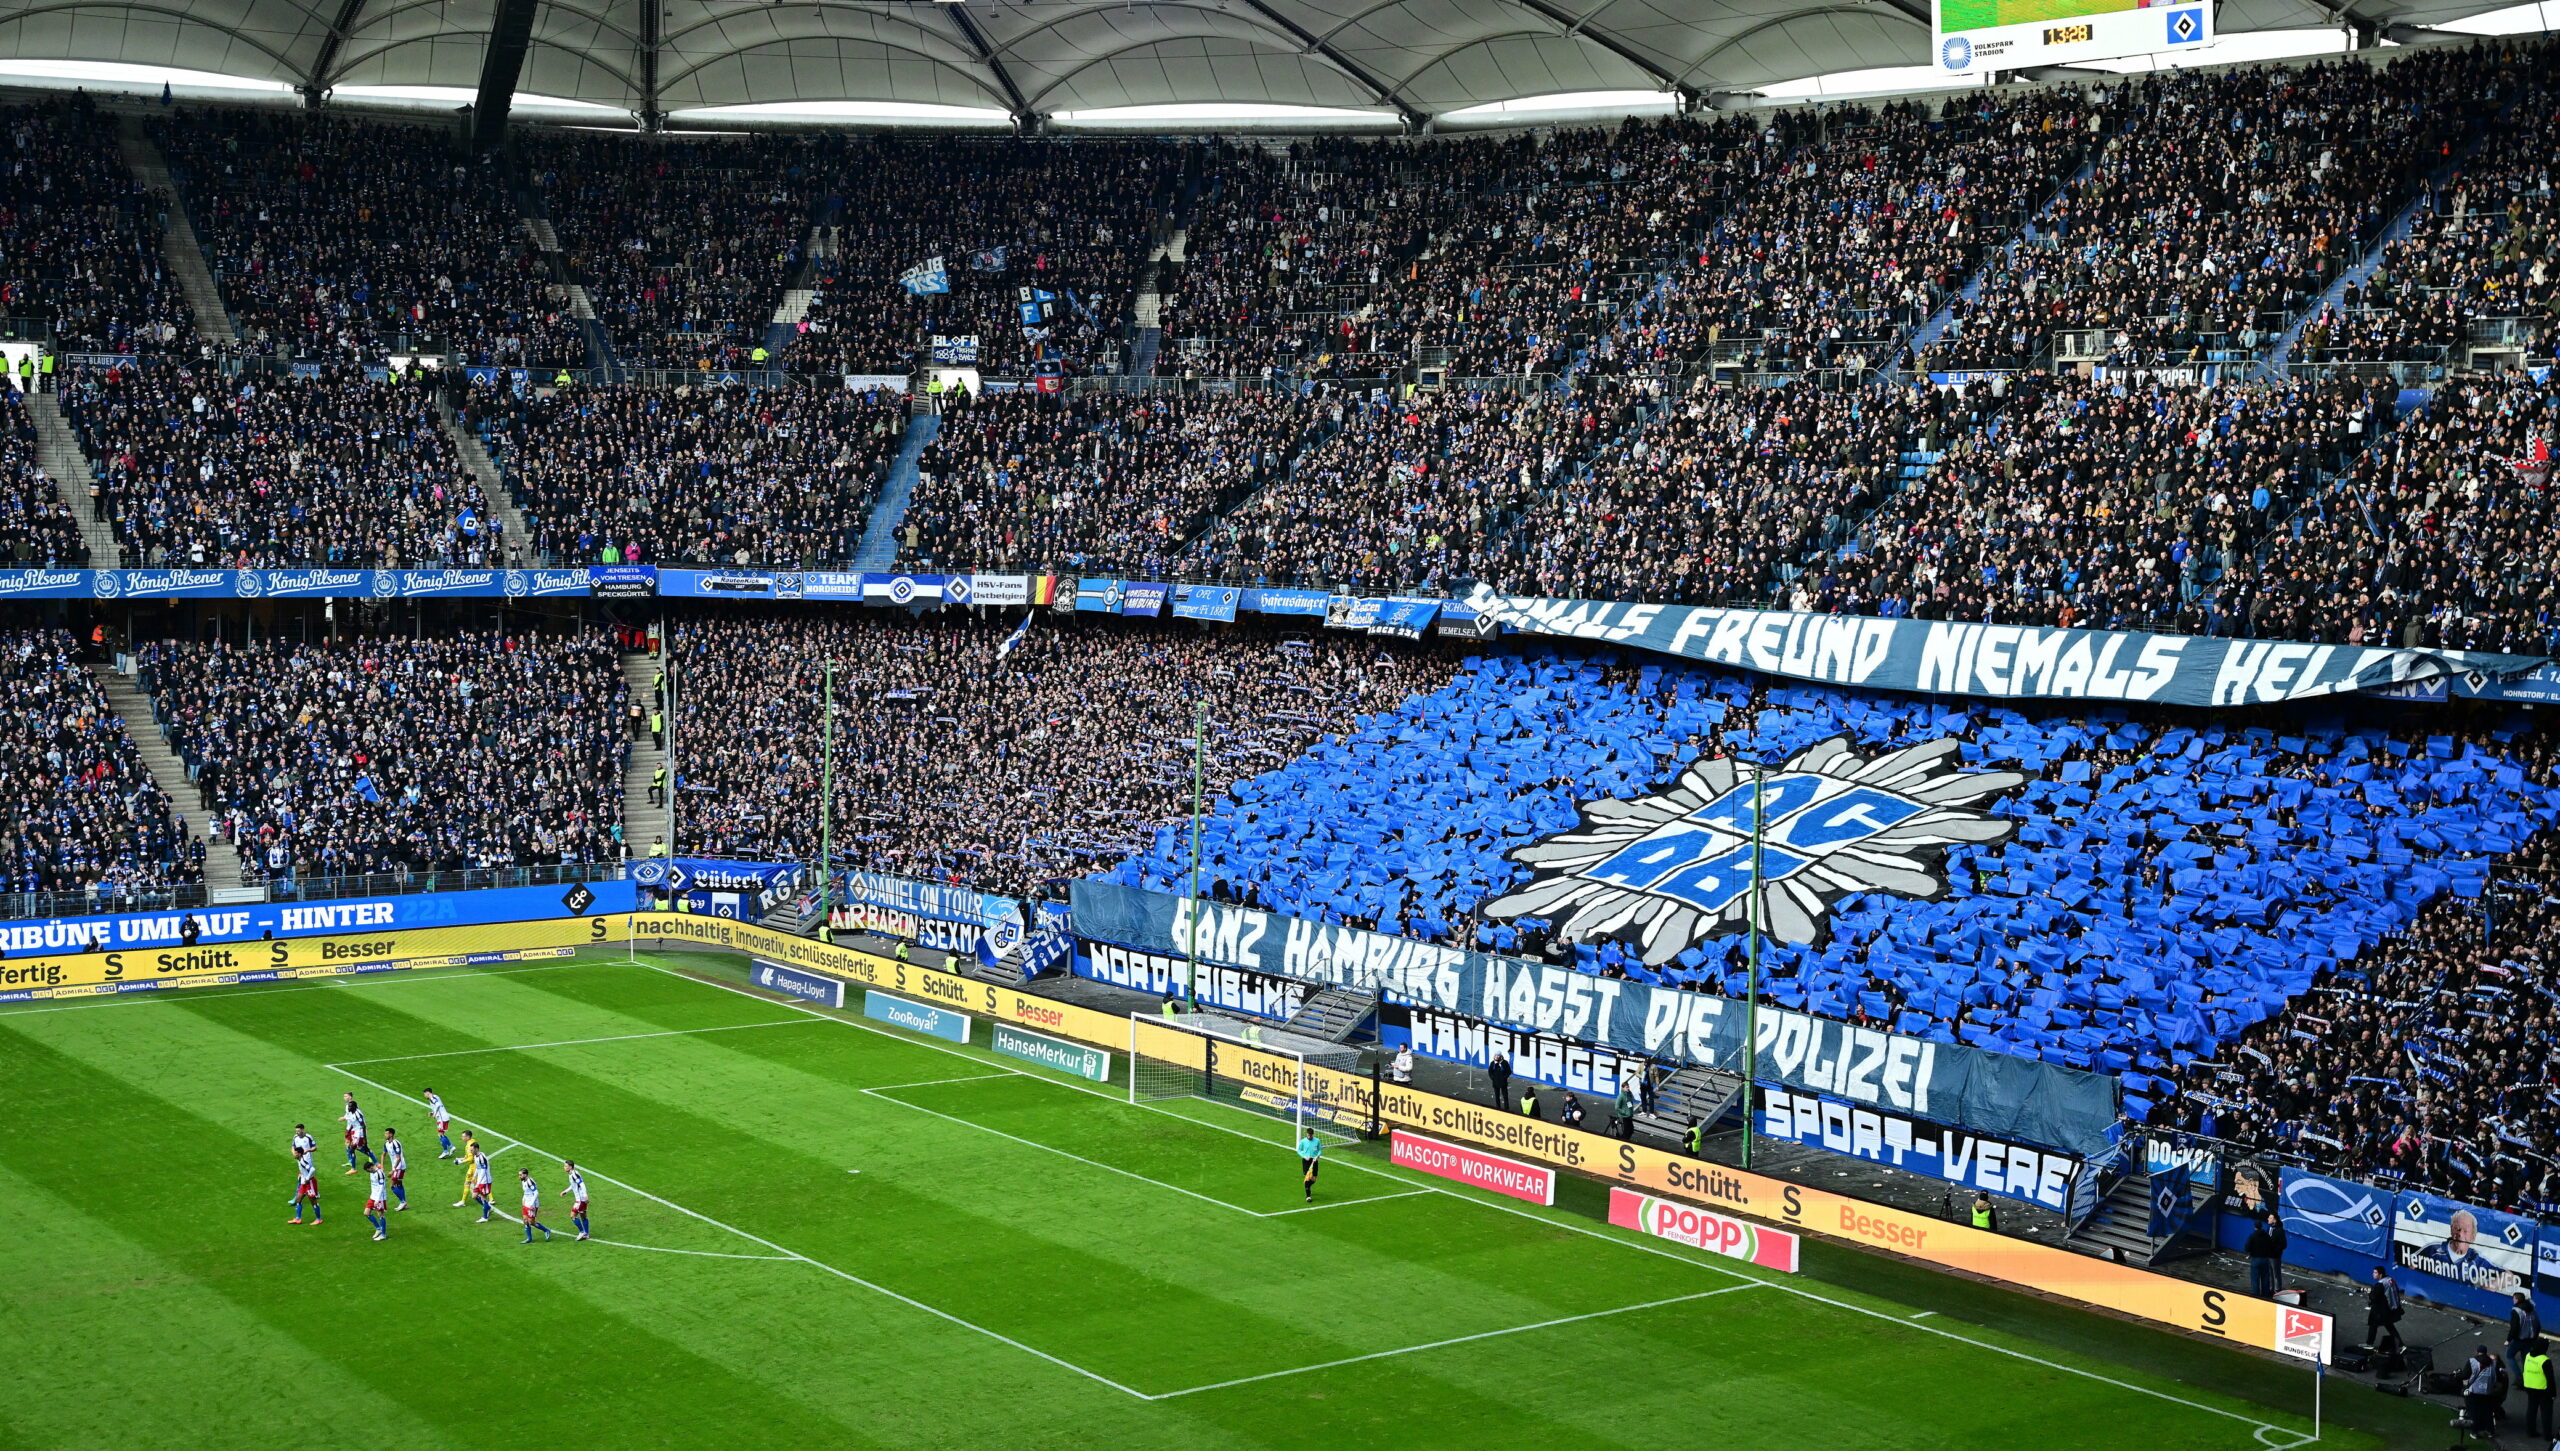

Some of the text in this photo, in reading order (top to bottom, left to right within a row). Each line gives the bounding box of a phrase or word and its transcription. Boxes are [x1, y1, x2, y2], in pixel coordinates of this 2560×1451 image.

[2048, 25, 2088, 44] 13:28
[1974, 40, 2014, 50] VOLKSPARK
[1974, 48, 2004, 57] STADION
[805, 585, 858, 594] NORDHEIDE
[820, 574, 857, 585] TEAM
[976, 581, 1023, 590] HSV-Fans
[973, 591, 1026, 601] Ostbelgien
[1210, 605, 1229, 617] 1887
[1669, 608, 1897, 684] FREUND
[1917, 622, 2190, 701] NIEMALS
[2503, 689, 2546, 700] HOHNSTORF
[694, 869, 763, 890] Lübeck
[869, 876, 983, 923] DANIEL ON TOUR
[281, 901, 394, 931] HINTER
[402, 898, 458, 922] 22A
[925, 920, 983, 953] SEXMA
[322, 940, 395, 960] Besser
[468, 954, 502, 963] ADMIRAL
[523, 950, 556, 958] ADMIRAL
[637, 919, 878, 982] nachhaltig, innovativ, schlüsselfertig.
[157, 949, 239, 973] Schütt.
[355, 963, 391, 973] ADMIRAL
[413, 959, 448, 967] ADMIRAL
[180, 977, 218, 986] ADMIRAL
[239, 973, 277, 982] ADMIRAL
[298, 968, 335, 977] ADMIRAL
[1090, 943, 1305, 1019] NORDTRIBÜNE
[55, 987, 95, 997] ADMIRAL
[118, 982, 157, 992] ADMIRAL
[777, 974, 826, 999] Hapag-Lloyd
[923, 974, 968, 1003] Schütt.
[1016, 998, 1063, 1027] Besser
[1171, 896, 1935, 1113] GANZ HAMBURG HASST DIE POLIZEI
[888, 1006, 934, 1032] ZooRoyal
[997, 1031, 1081, 1069] HanseMerkur
[1243, 1089, 1271, 1103] ADMIRAL
[1242, 1058, 1335, 1102] nachhaltig,
[1433, 1107, 1585, 1166] schlüsselfertig.
[1765, 1089, 2079, 1208] SPORT-VERE
[1461, 1158, 1544, 1196] WORKWEAR
[1667, 1162, 1748, 1204] Schütt.
[1840, 1204, 1927, 1250] Besser
[1667, 1230, 1699, 1245] FEINKOST
[2402, 1244, 2522, 1292] Hermann FOREVER
[2201, 1290, 2226, 1326] S
[2283, 1345, 2319, 1359] BUNDESLIG
